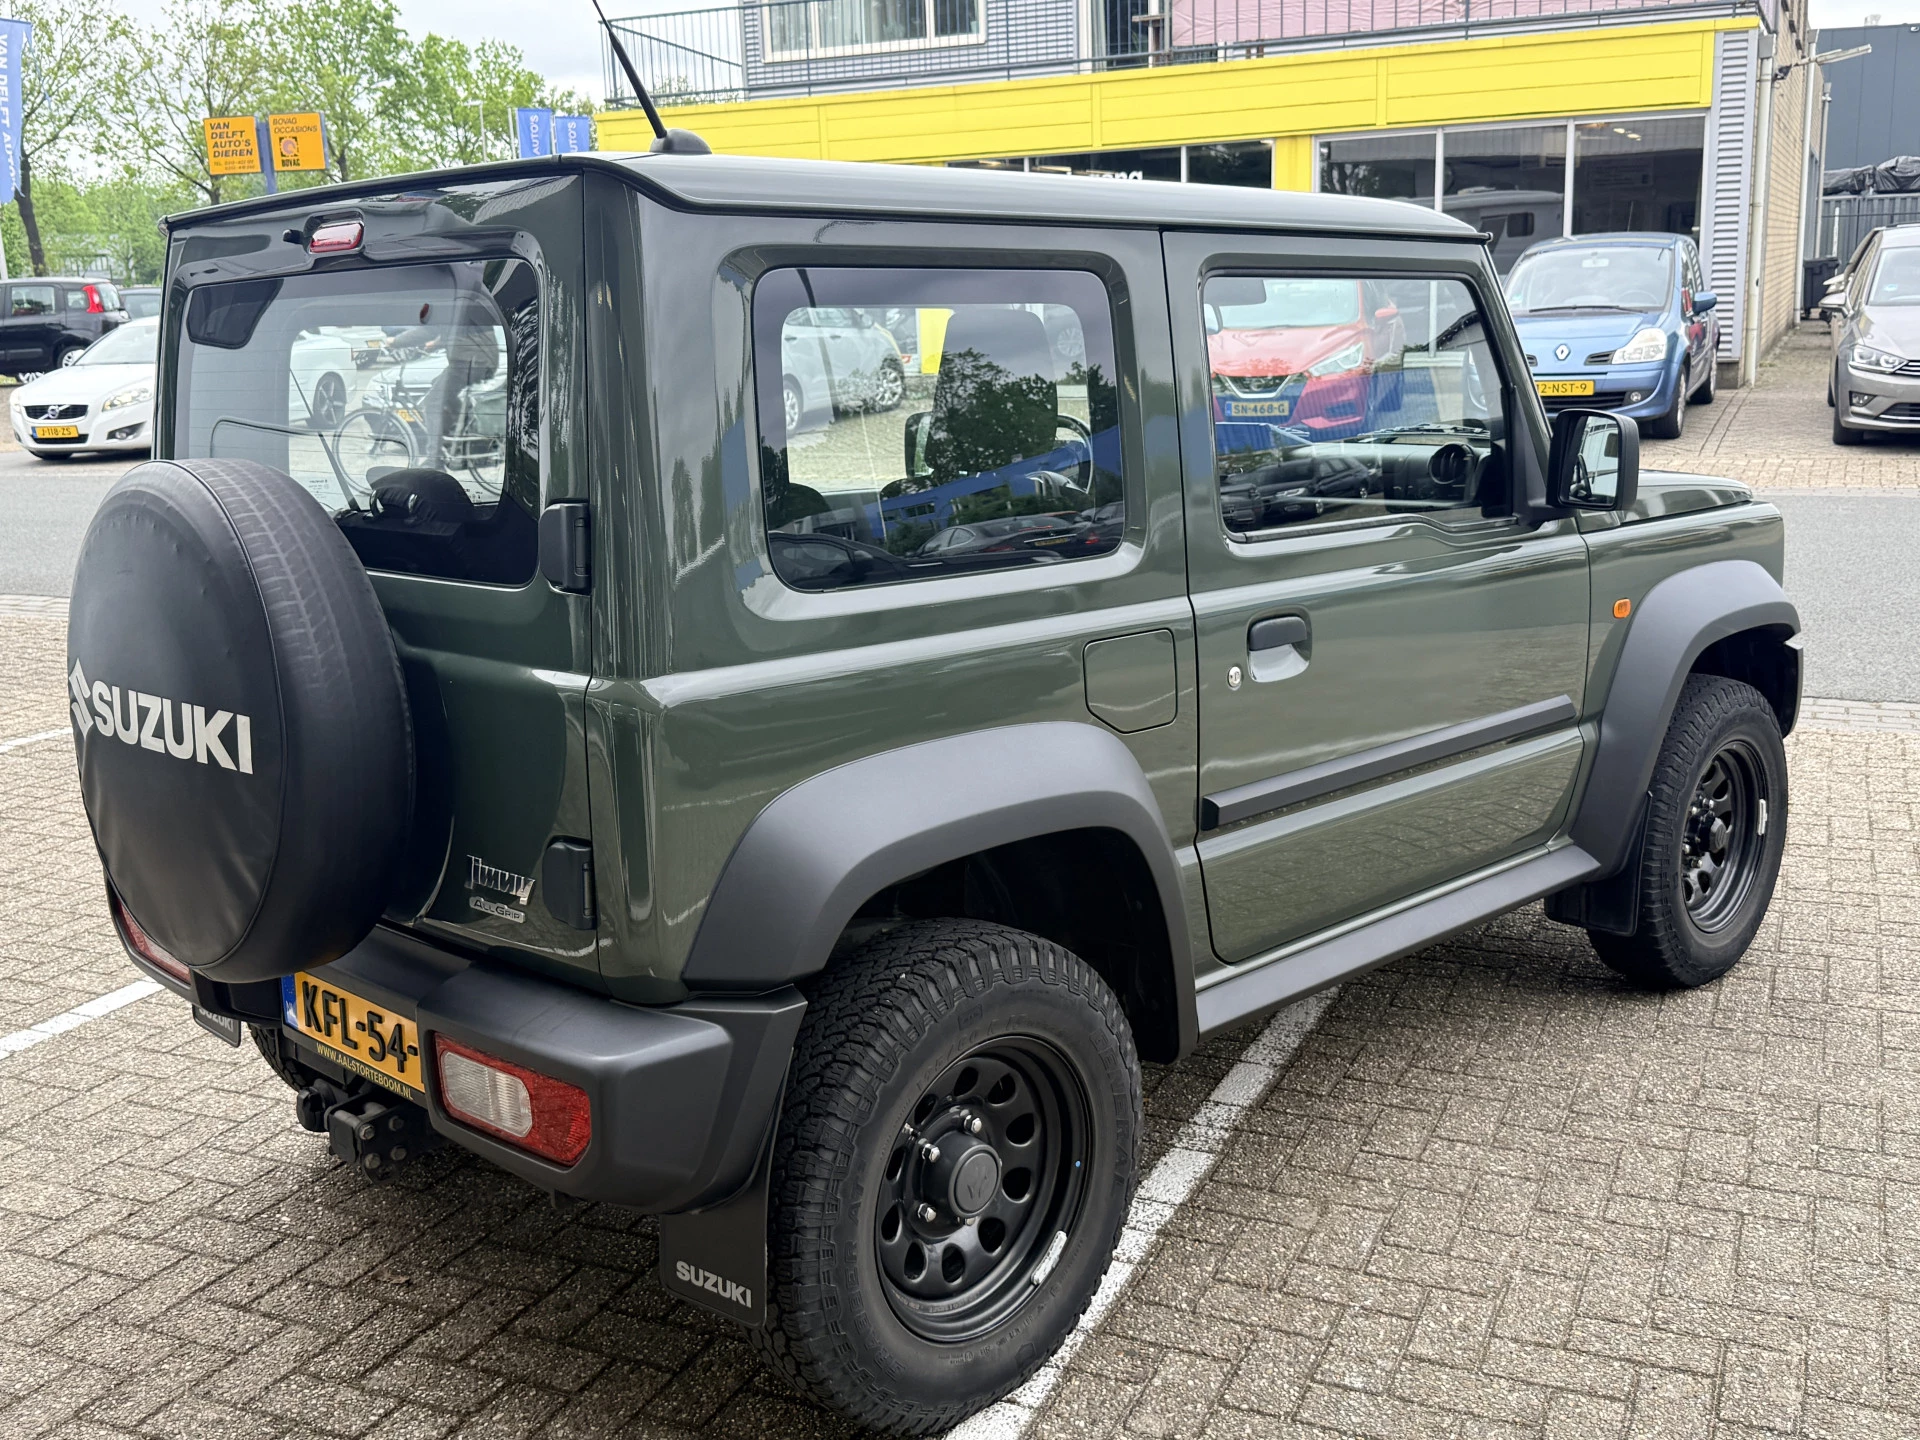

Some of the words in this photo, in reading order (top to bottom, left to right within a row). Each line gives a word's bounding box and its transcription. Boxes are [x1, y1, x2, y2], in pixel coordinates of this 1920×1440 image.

[0, 33, 8, 69] VAN
[0, 74, 10, 128] DELFT
[209, 122, 230, 131] VAN
[273, 117, 297, 126] BOVAG
[211, 130, 245, 139] DELFT
[274, 125, 318, 134] OCCASIONS
[530, 114, 541, 156] AUTO'S
[567, 121, 579, 152] UTO'S
[212, 139, 251, 149] AUTO'S
[213, 148, 253, 158] DIEREN
[281, 159, 301, 167] BOVAG
[1233, 403, 1286, 415] SN-468-G
[92, 680, 254, 775] SUZUKI
[302, 980, 419, 1074] KFL-54-
[676, 1260, 752, 1309] SUZUKI
